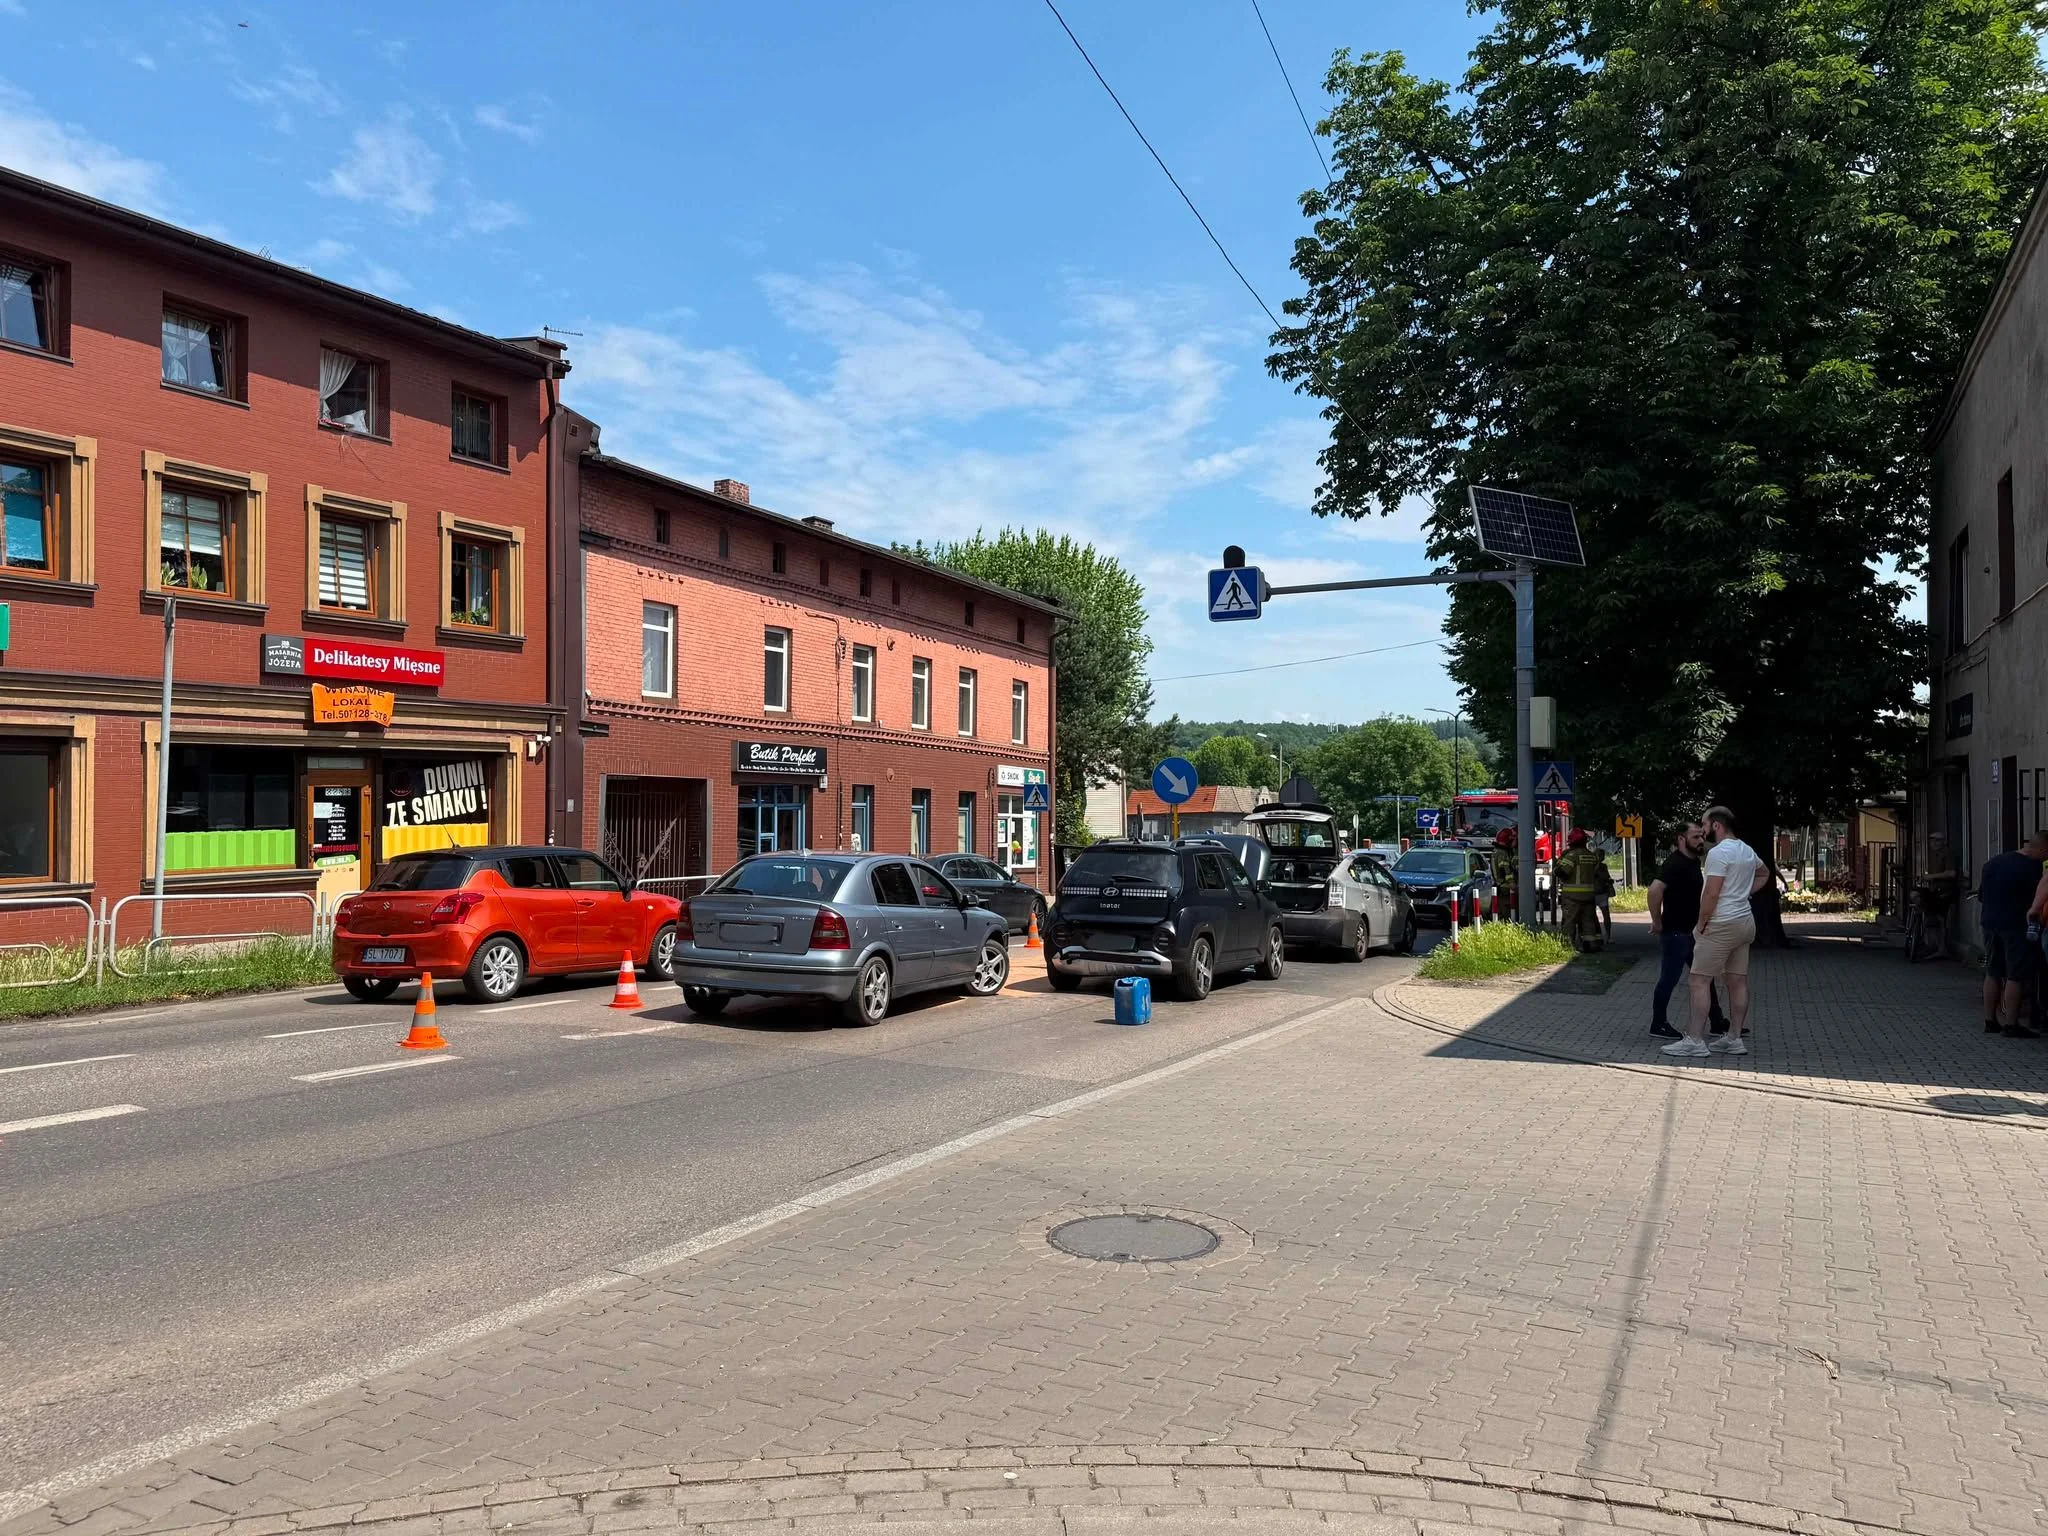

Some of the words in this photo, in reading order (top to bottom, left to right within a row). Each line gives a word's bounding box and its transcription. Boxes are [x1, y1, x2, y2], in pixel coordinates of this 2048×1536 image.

[268, 649, 302, 659] MASARNIA
[314, 647, 390, 672] Delikatesy
[393, 655, 441, 676] Mięsne
[268, 657, 301, 669] JÓZEFA
[332, 698, 372, 707] LOKAL
[750, 743, 779, 760] Butik
[781, 746, 817, 766] Perfekt
[423, 759, 485, 795] DUMNI
[386, 800, 409, 828] ZE
[411, 786, 477, 825] SMAKU
[368, 948, 377, 959] SL
